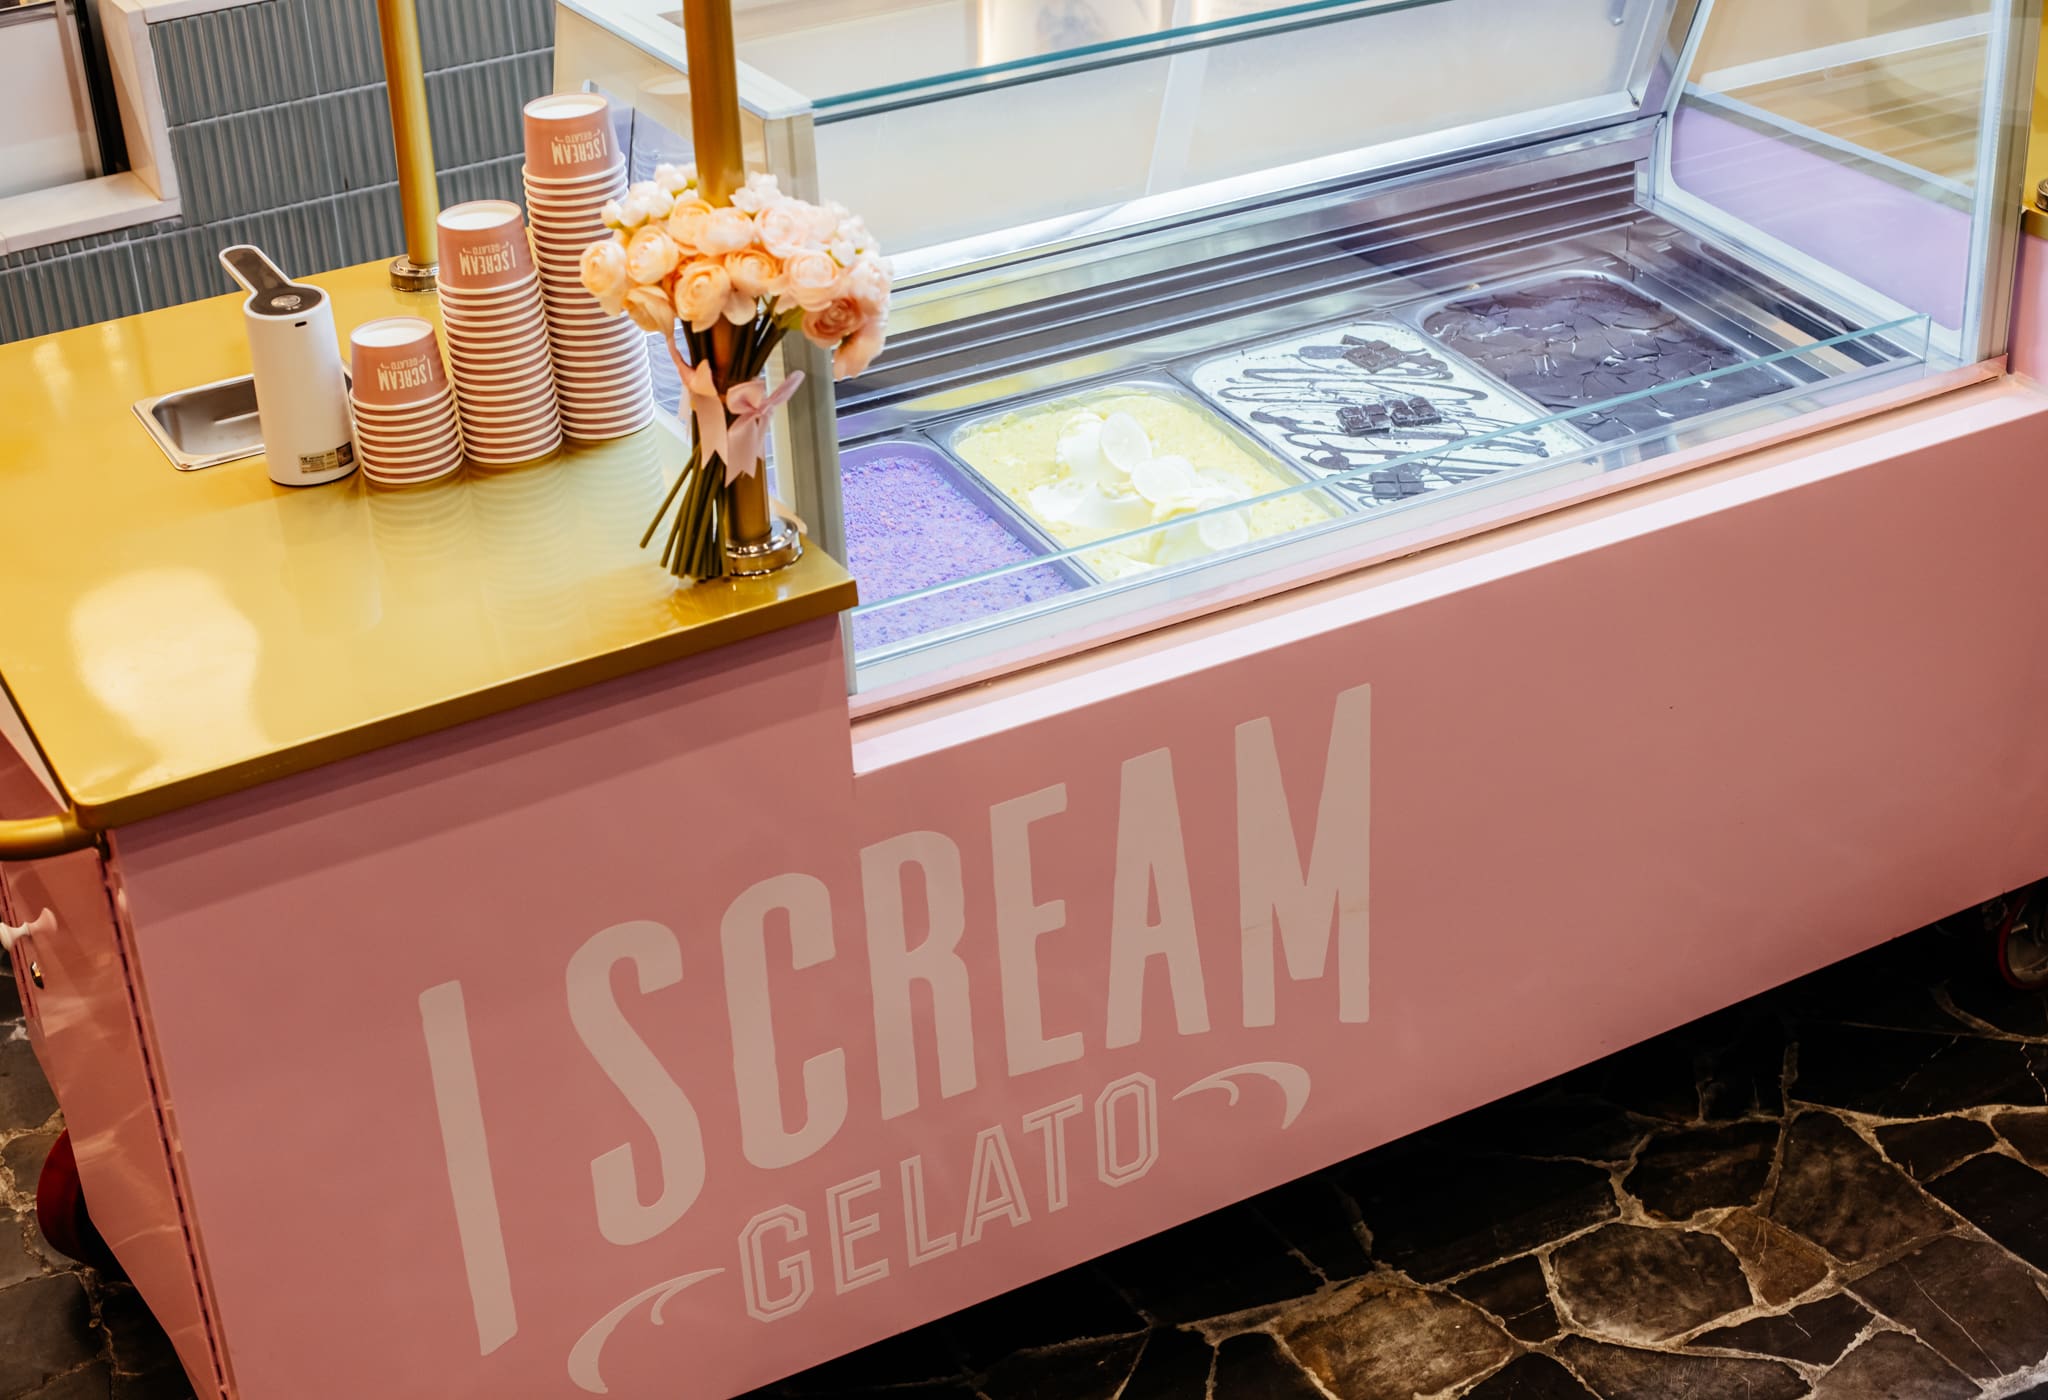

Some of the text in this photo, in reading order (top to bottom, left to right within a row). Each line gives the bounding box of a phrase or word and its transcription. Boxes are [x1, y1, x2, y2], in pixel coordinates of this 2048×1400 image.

[551, 132, 607, 166] I SCREAM
[564, 131, 593, 144] GELATO
[459, 244, 517, 276] I SCREAM
[472, 243, 500, 255] GELATO
[377, 358, 433, 391] I SCREAM
[390, 357, 419, 370] GELATO
[418, 683, 1372, 1356] I SCREAM
[738, 1072, 1159, 1323] GELATO
